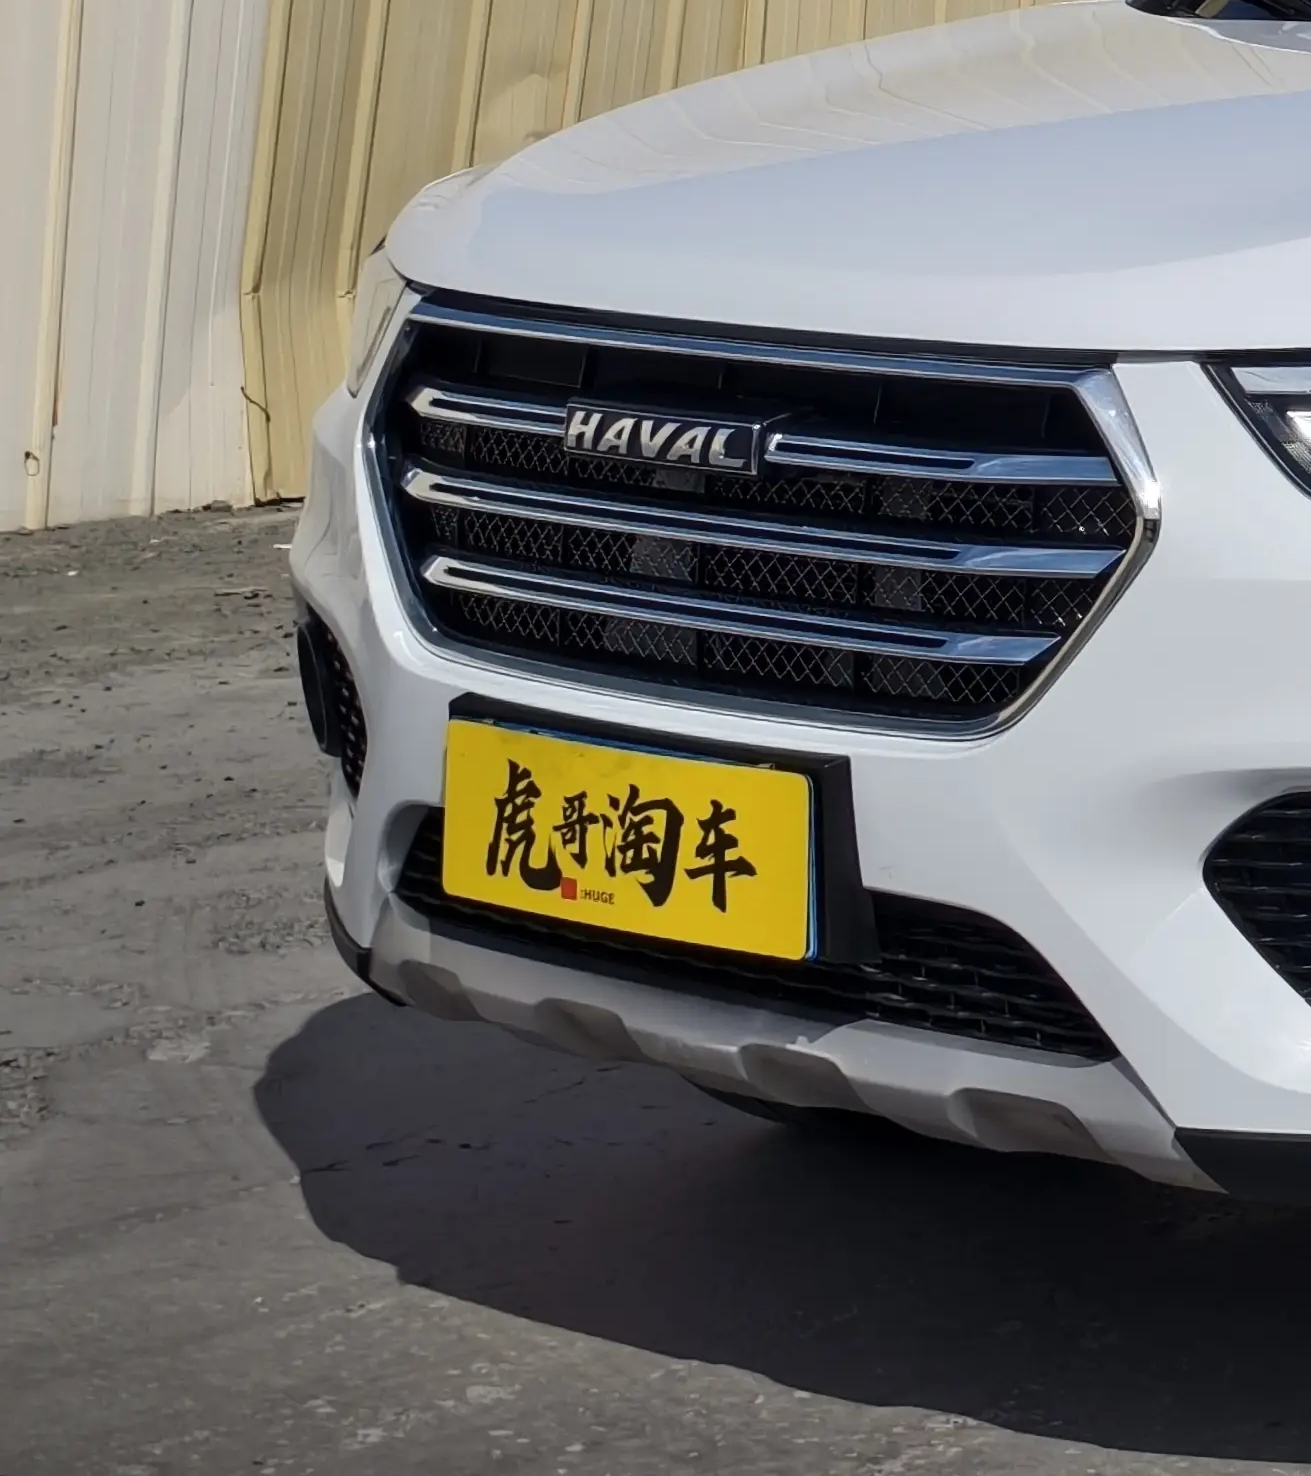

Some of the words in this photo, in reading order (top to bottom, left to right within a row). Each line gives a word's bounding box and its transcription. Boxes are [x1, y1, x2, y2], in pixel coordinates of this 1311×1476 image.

[567, 410, 747, 468] HAVAL
[485, 758, 758, 913] 虎哥淘车
